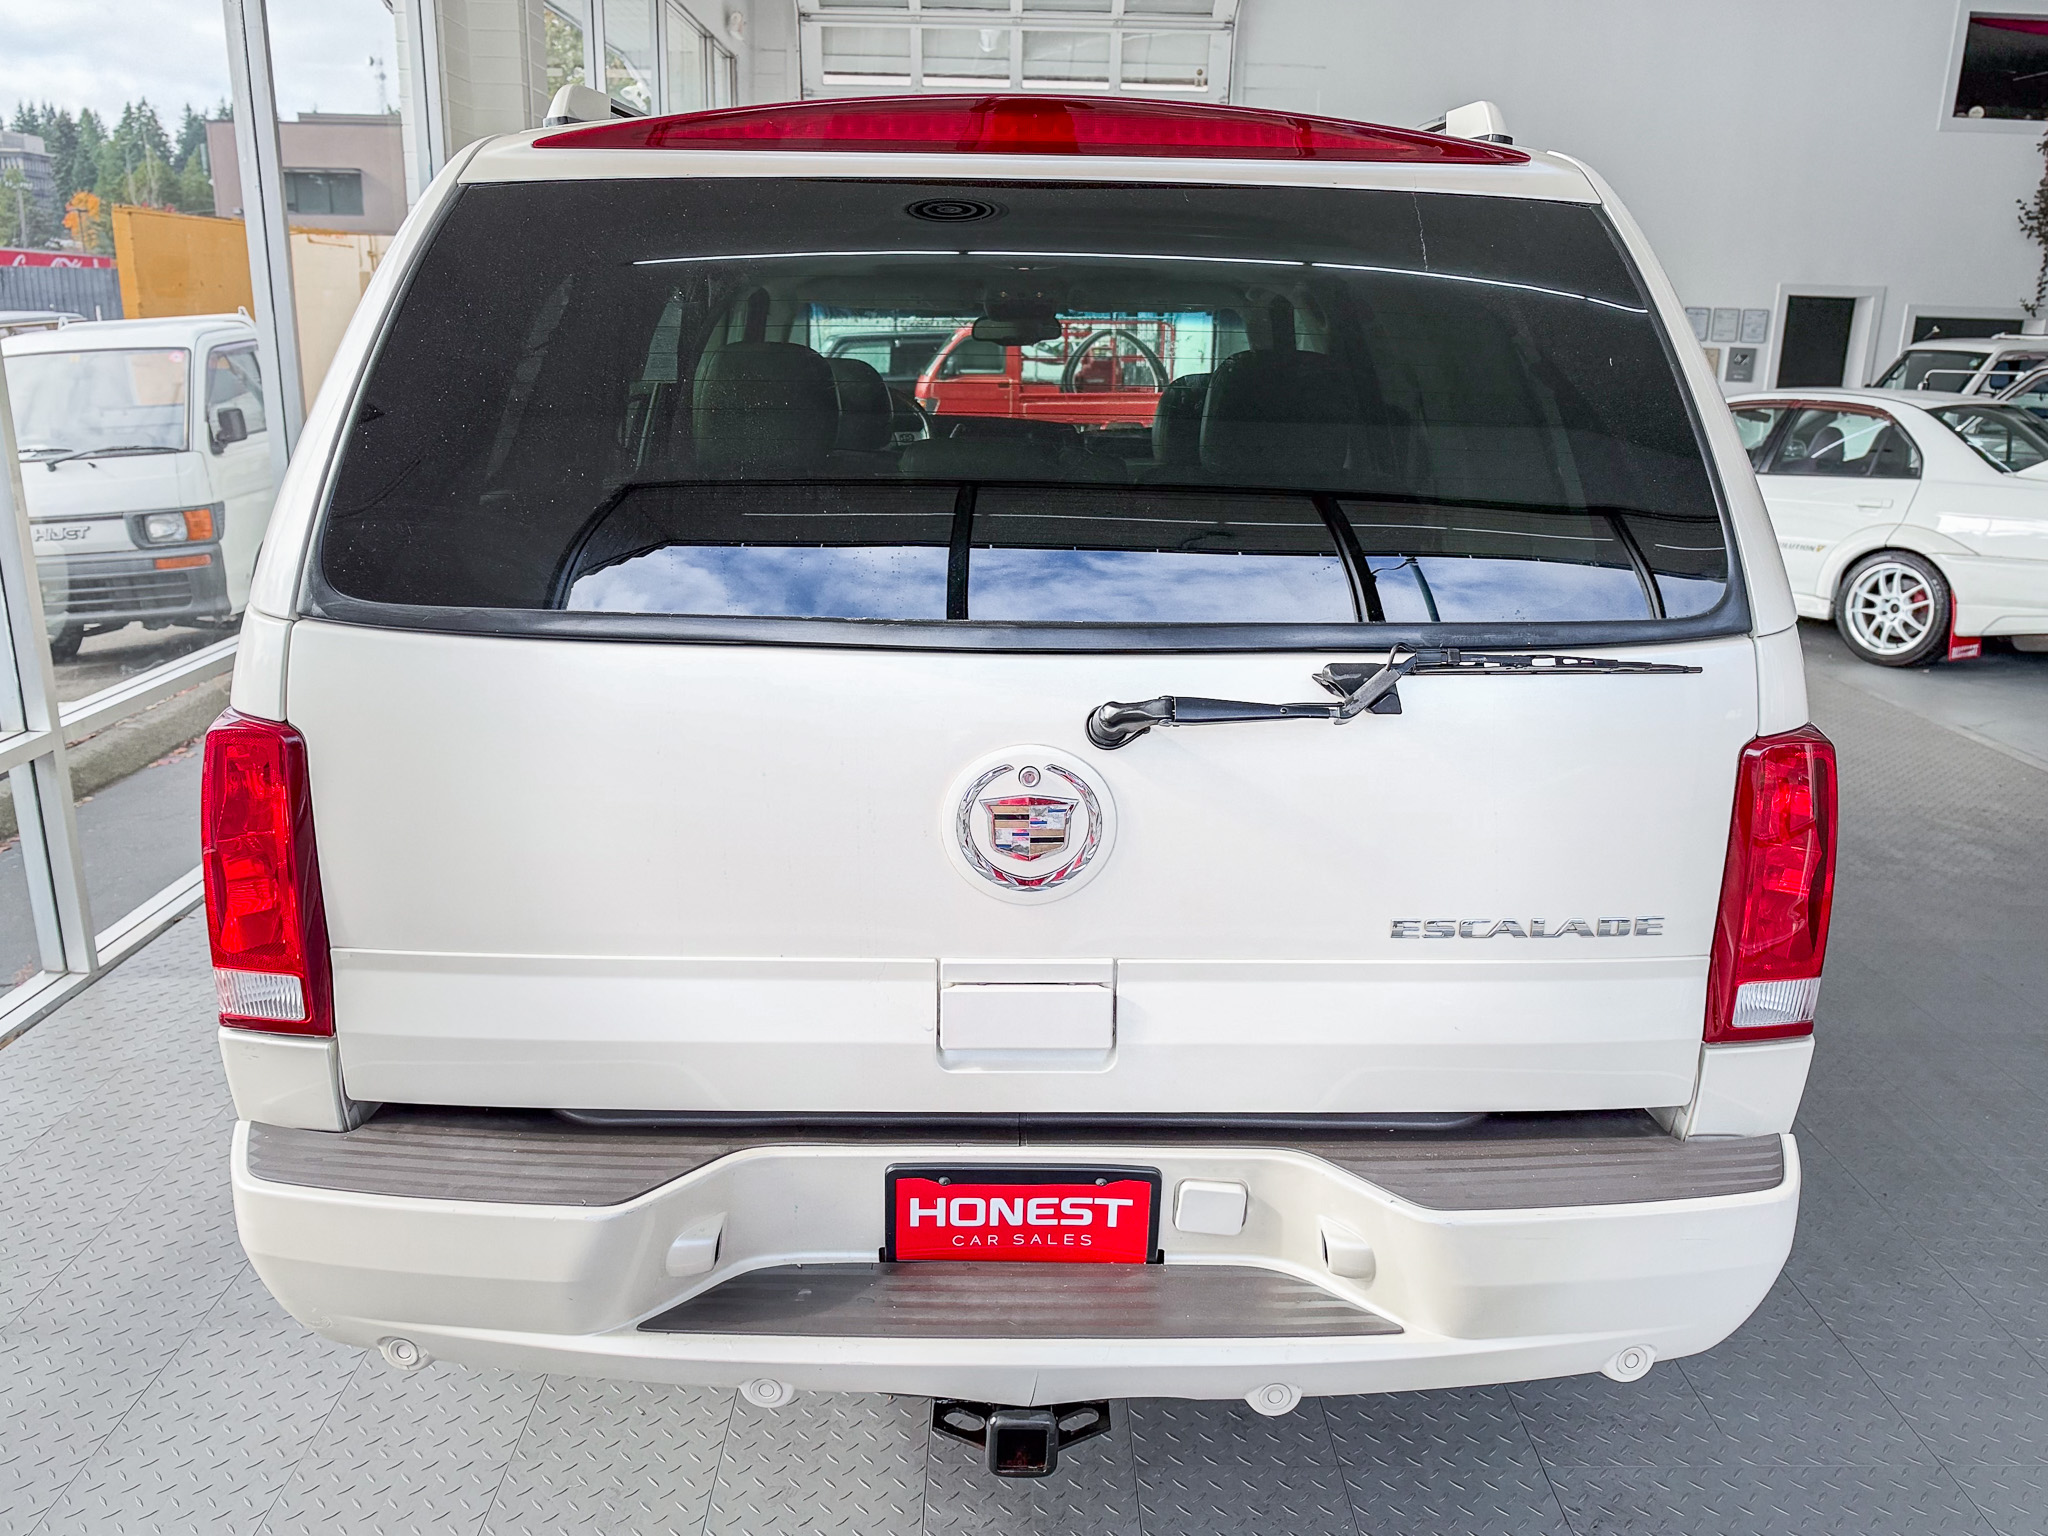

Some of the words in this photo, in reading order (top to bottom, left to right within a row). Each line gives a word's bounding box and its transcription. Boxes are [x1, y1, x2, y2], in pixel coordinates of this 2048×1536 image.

[1390, 916, 1665, 938] ESCALADE
[910, 1197, 1133, 1227] HONEST
[952, 1234, 998, 1246] CAR
[1013, 1233, 1092, 1246] SALES
